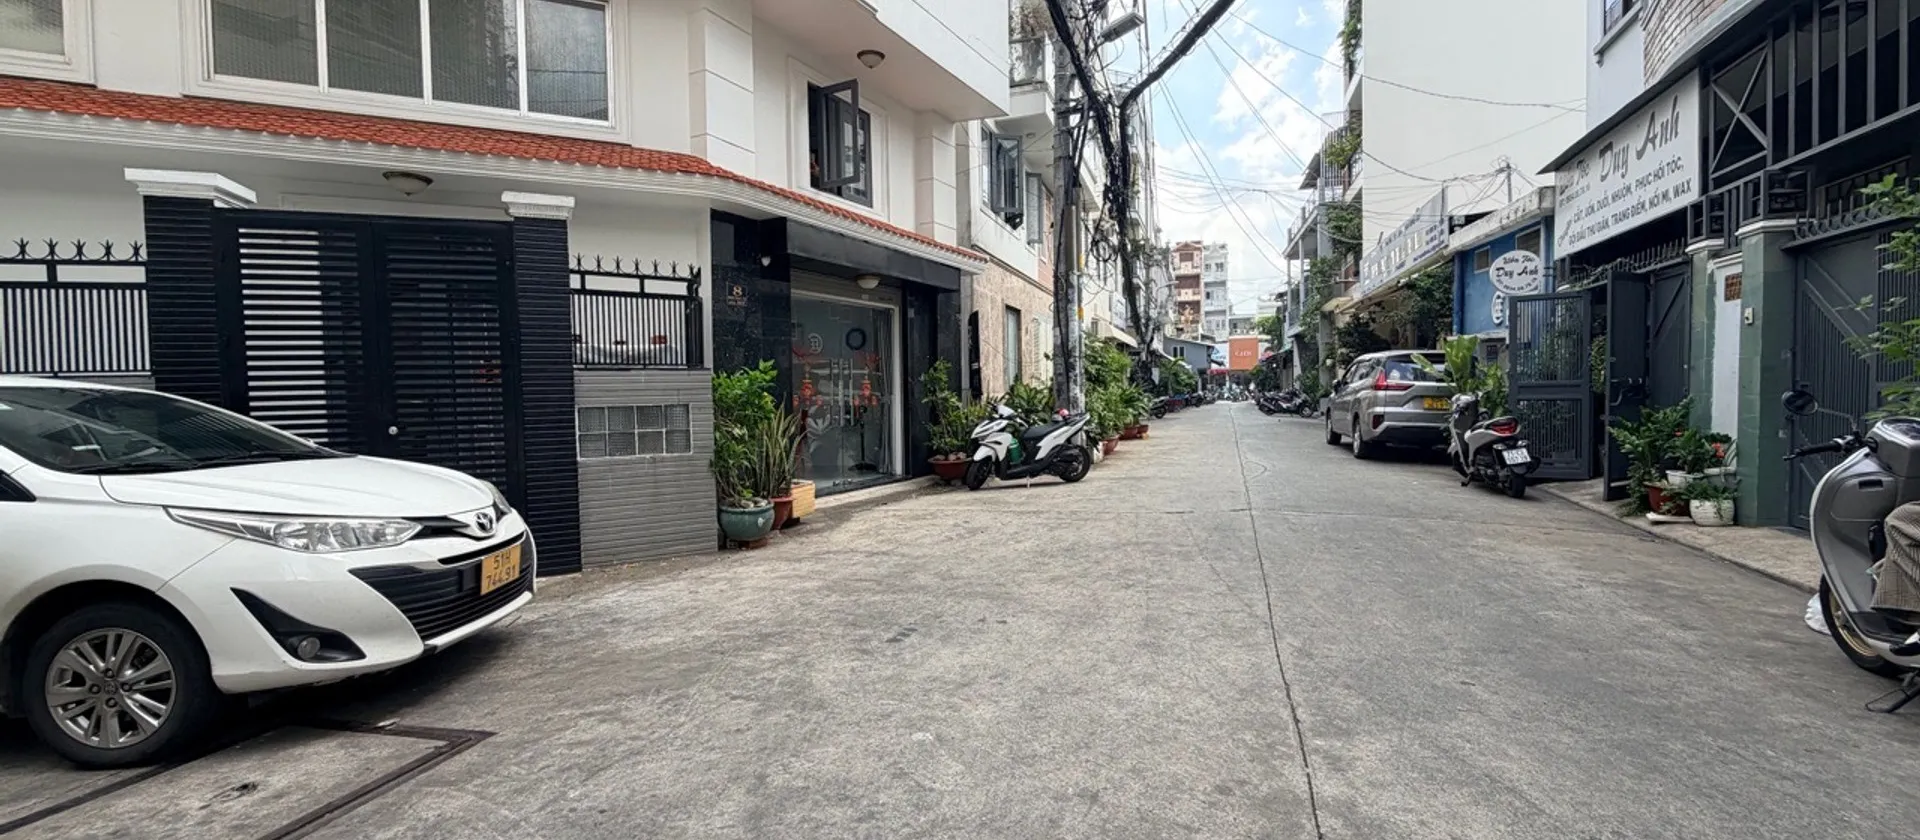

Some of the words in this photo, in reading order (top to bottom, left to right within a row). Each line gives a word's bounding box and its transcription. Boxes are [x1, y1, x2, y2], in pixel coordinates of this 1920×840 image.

[1599, 141, 1629, 182] Duy
[1636, 94, 1679, 160] Anh
[1673, 177, 1691, 198] WAX
[1496, 267, 1514, 279] Duy
[1517, 265, 1538, 276] Anh
[733, 285, 743, 297] 8
